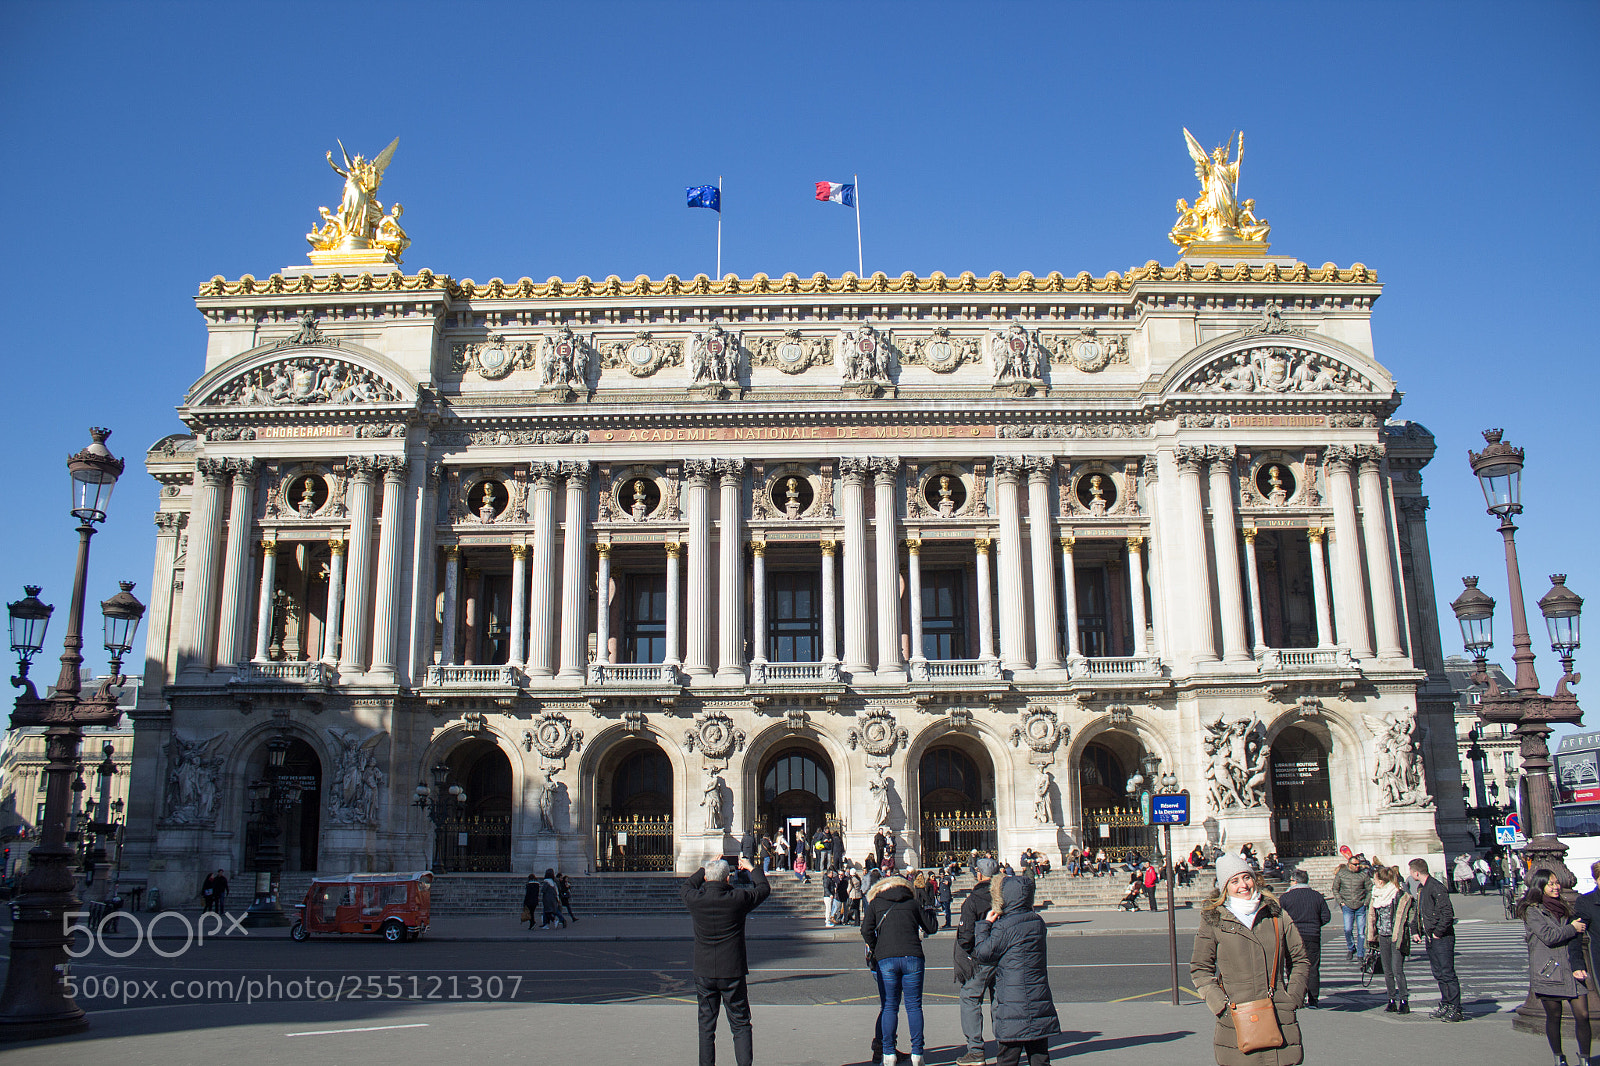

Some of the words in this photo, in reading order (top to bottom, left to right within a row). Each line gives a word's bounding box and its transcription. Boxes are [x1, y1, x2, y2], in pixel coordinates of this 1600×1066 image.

[1237, 416, 1273, 427] POESIE
[1279, 416, 1319, 427] LYRIQUE
[265, 426, 343, 438] CHOREGRAPHIE
[628, 429, 718, 441] ACADEMIE
[734, 427, 820, 440] NATIONALE
[836, 427, 859, 439] DE
[875, 426, 956, 439] MUSIQUE
